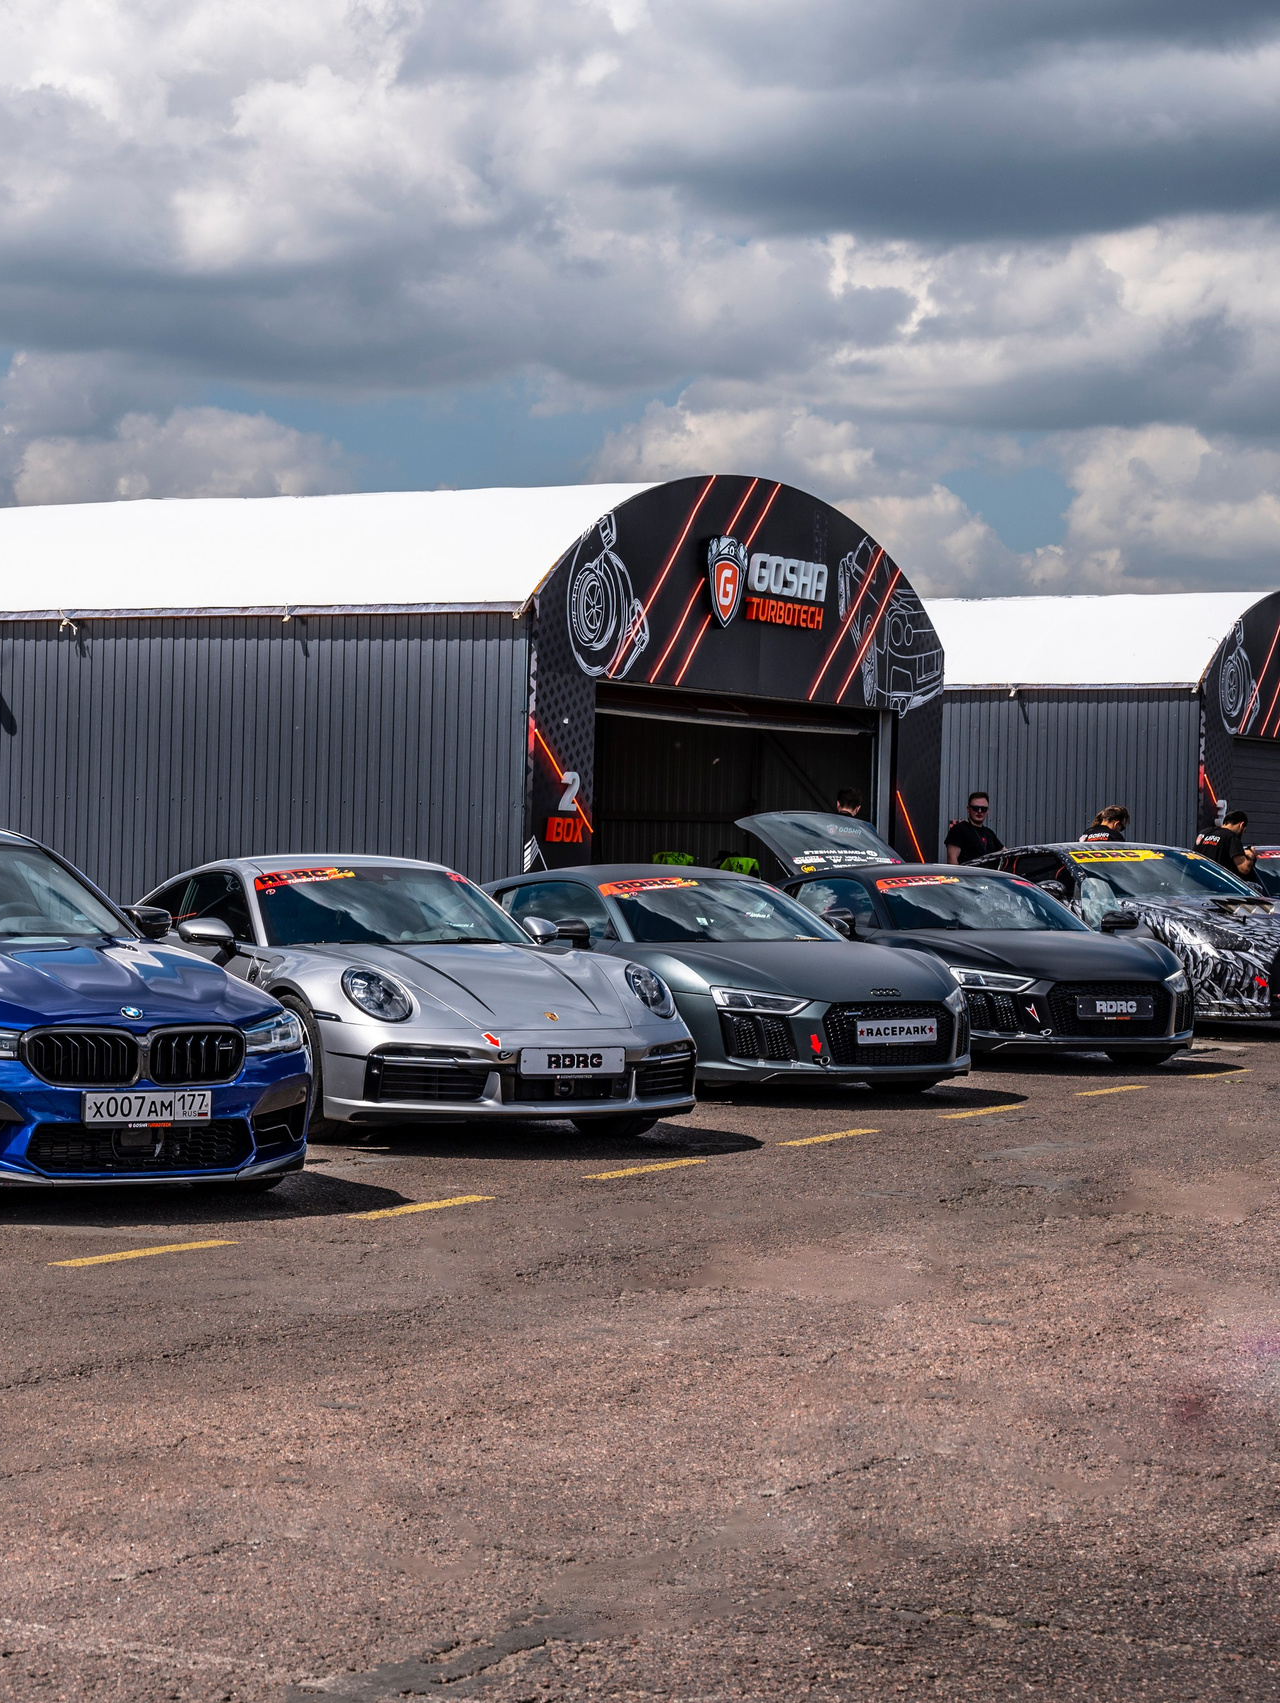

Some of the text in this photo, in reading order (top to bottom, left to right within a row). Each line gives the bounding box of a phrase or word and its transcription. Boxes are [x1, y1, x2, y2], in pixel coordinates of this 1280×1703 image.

[747, 553, 828, 602] GOSHA
[745, 596, 824, 630] TURBOTECH
[557, 771, 581, 811] 2
[545, 817, 584, 843] BOX
[1096, 1001, 1137, 1013] RDRC
[866, 1025, 928, 1037] RACEPARK
[177, 1093, 207, 1111] 177
